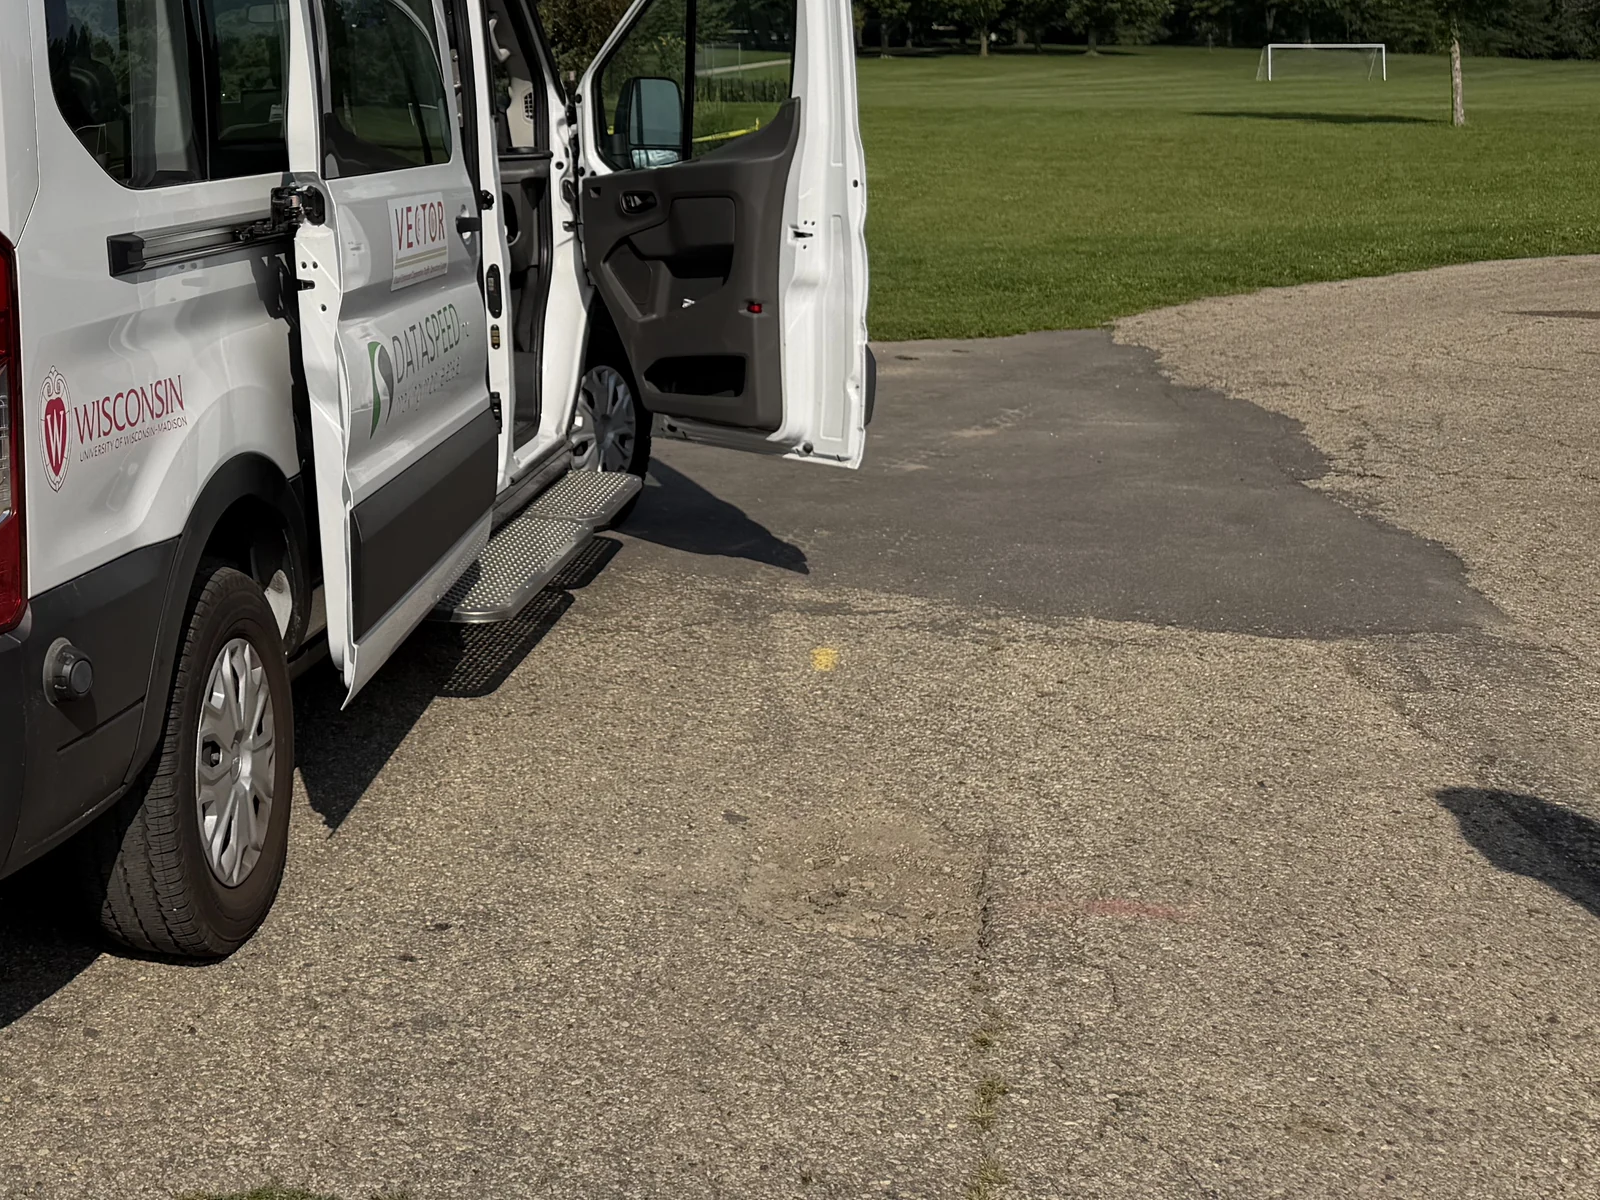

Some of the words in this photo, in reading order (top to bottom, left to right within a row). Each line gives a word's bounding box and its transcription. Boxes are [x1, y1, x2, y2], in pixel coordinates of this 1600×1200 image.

[395, 201, 445, 250] VECTOR
[392, 303, 460, 384] DATASPEED
[74, 375, 184, 445] WISCONSIN
[79, 440, 114, 462] UNIVERSITY
[114, 436, 123, 450] OF
